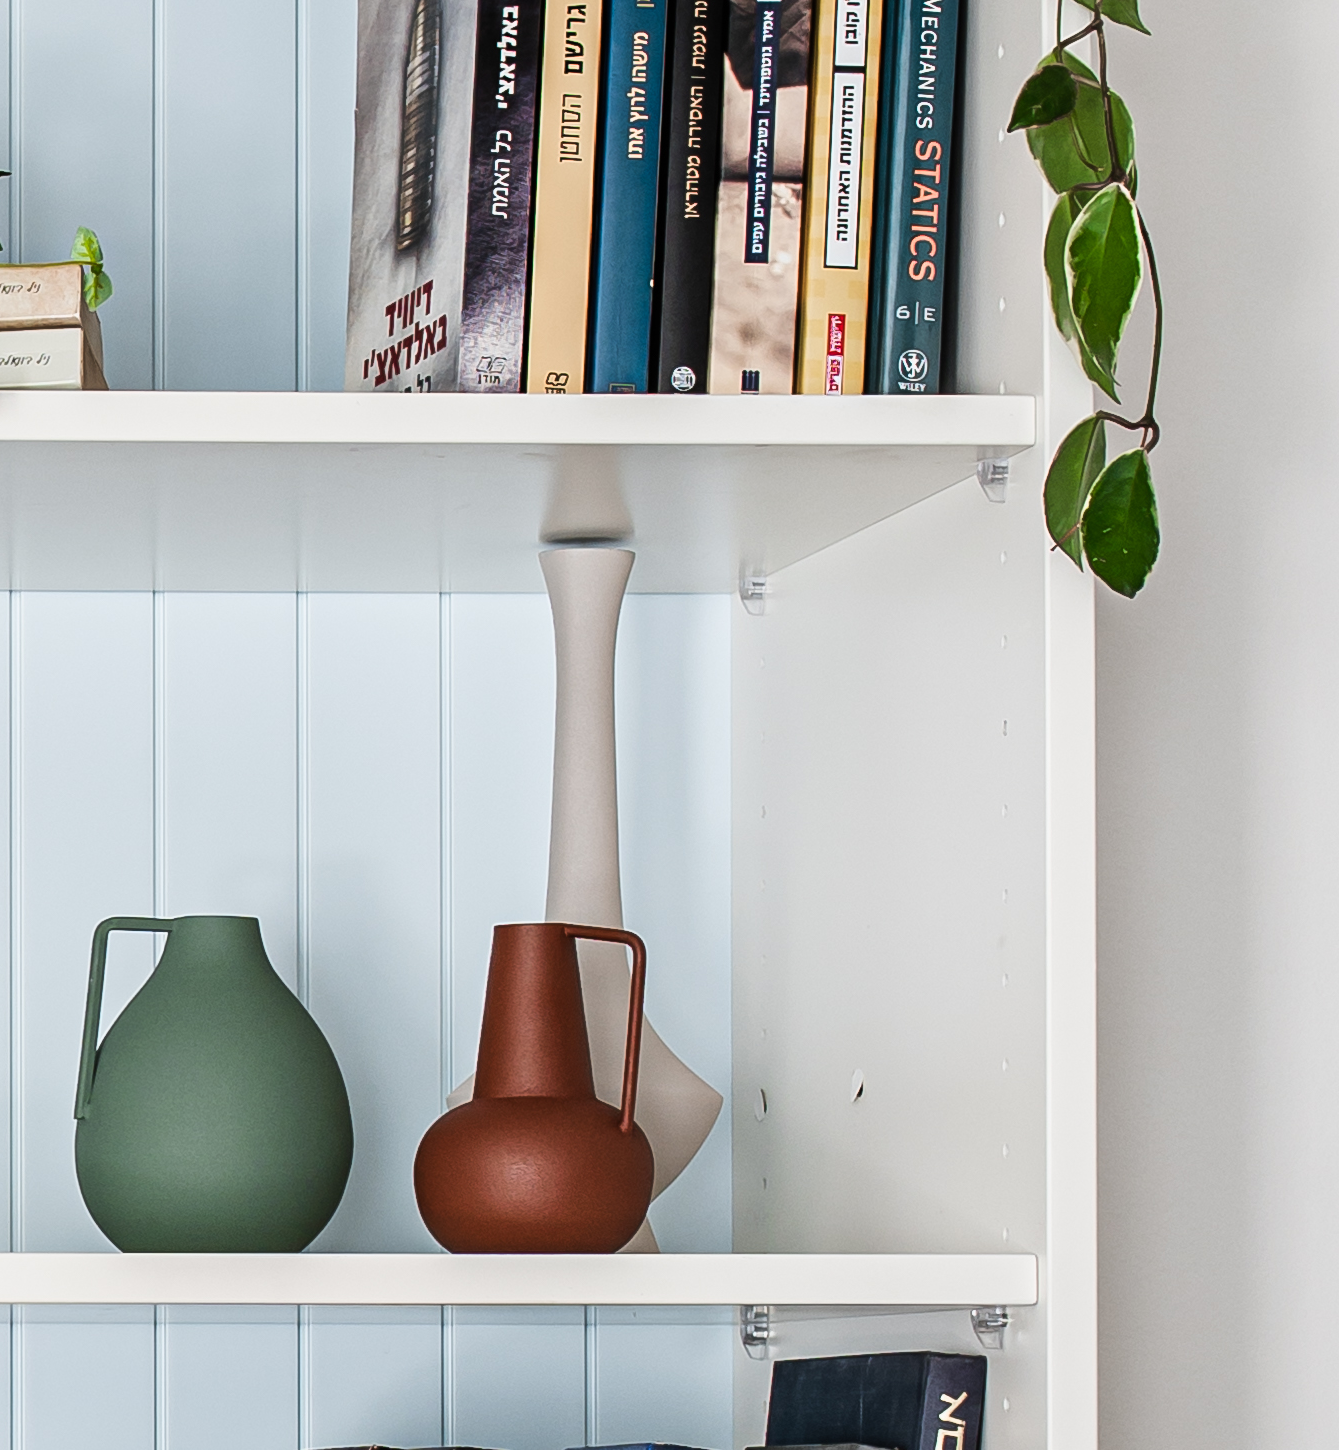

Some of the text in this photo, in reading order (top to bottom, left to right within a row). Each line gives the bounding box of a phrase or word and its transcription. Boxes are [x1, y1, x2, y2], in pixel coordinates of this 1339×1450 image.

[562, 4, 586, 75] גרישם
[689, 25, 707, 69] נעמת
[758, 11, 775, 107] אמיר גוטפרוינד
[842, 13, 864, 46] קובן
[559, 93, 582, 162] הסחטן
[627, 32, 649, 160] מישהו לרוץ אתו
[490, 129, 512, 219] כל האמת
[682, 85, 705, 219] האסירה מטהראן
[751, 118, 770, 254] בשבילה גיבורים עפים
[836, 85, 856, 242] ההזדמנות האחרונה
[907, 138, 943, 281] STATICS
[385, 279, 434, 338] דיוויד
[897, 381, 927, 392] WILEY
